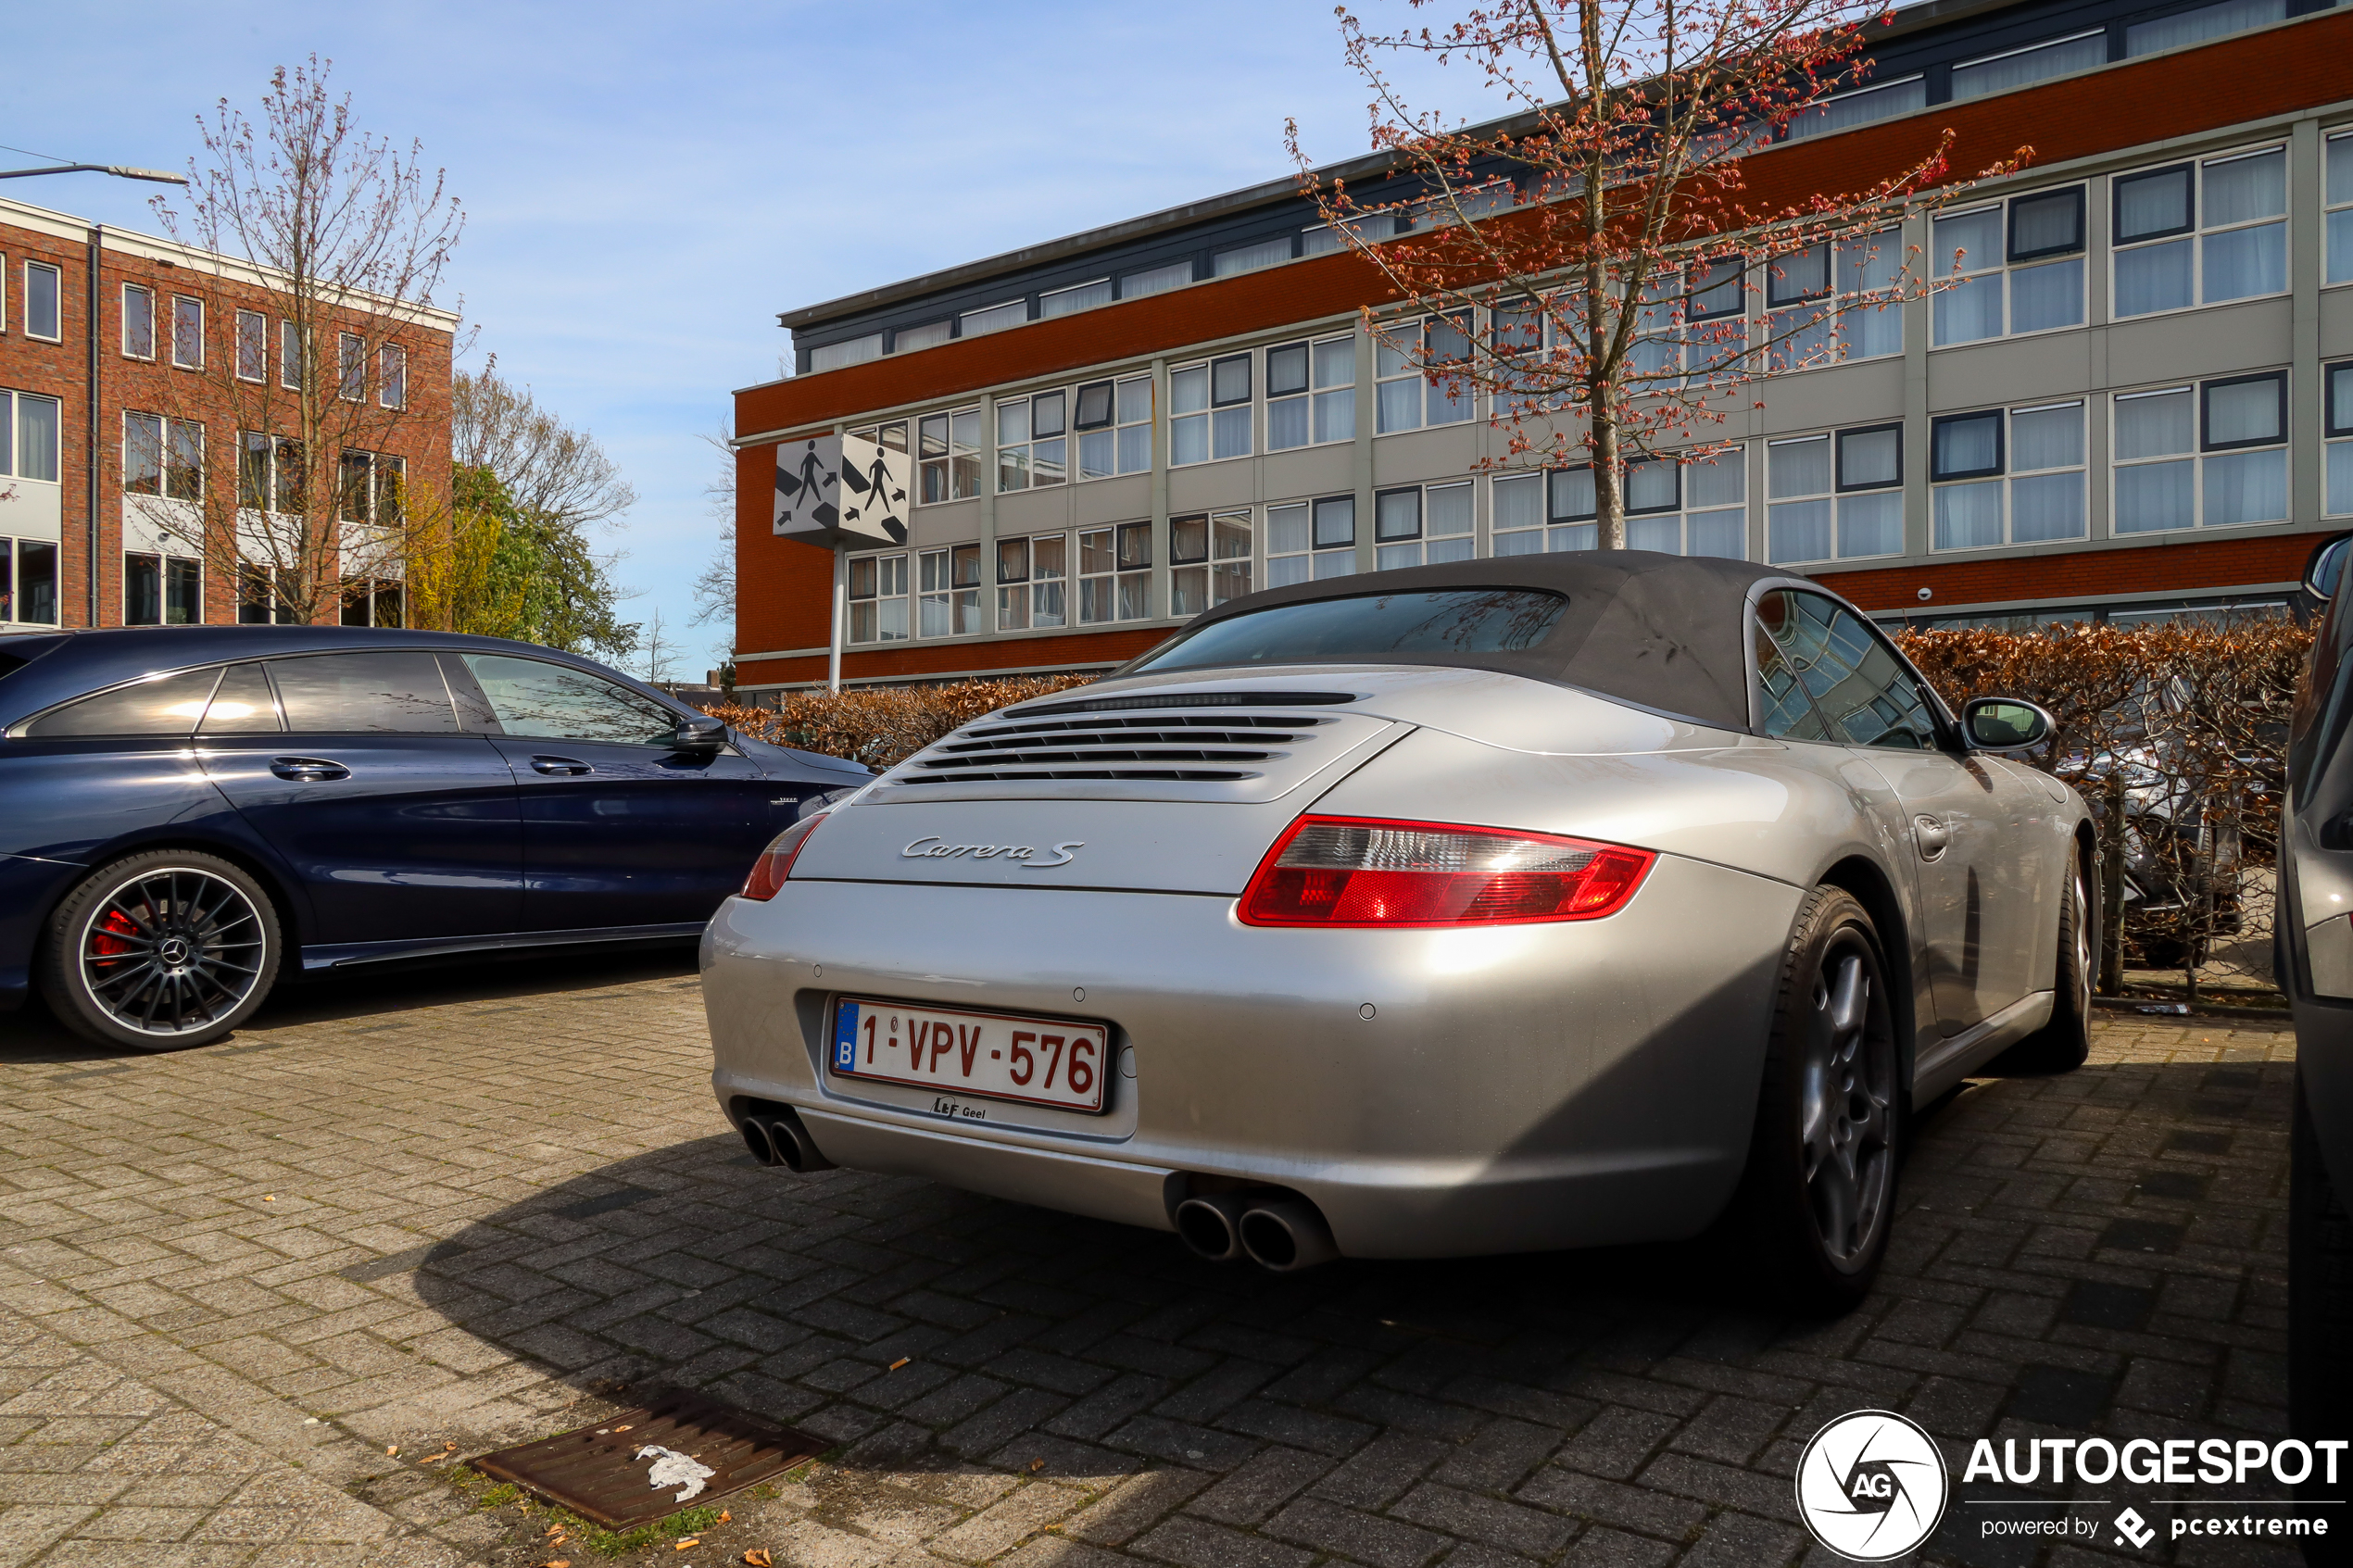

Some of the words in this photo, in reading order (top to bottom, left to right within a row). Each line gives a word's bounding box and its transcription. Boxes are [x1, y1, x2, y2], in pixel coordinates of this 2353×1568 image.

[901, 836, 1034, 859] Carrera
[1022, 842, 1085, 867] S
[839, 1042, 852, 1064] B
[963, 1107, 986, 1119] Geel
